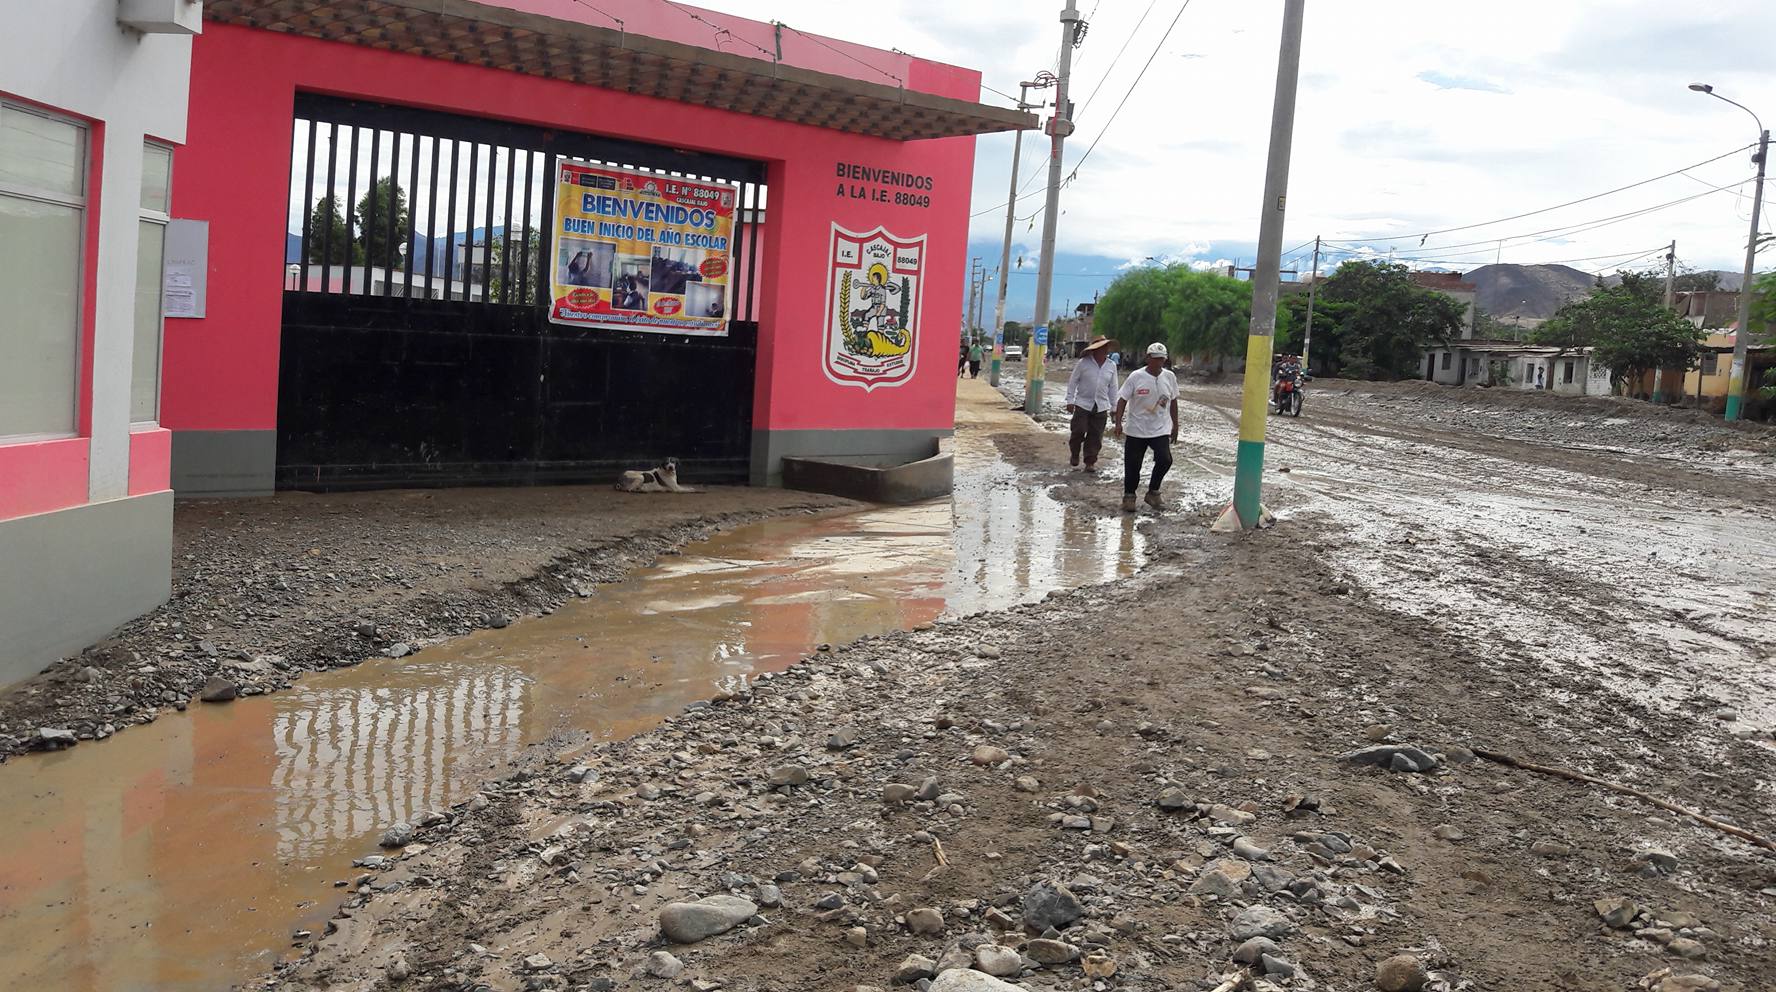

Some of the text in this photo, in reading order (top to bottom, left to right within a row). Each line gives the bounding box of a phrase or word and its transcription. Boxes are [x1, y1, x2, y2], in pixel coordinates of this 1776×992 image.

[837, 163, 933, 191] BIENVENIDOS
[665, 184, 679, 195] I.E.
[693, 188, 720, 200] 88049
[837, 183, 930, 208] A LA I.E. 88049
[582, 193, 716, 229] BIENVENIDOS
[563, 217, 728, 250] BUEN INICIO DEL AÑO ESCOLAR
[841, 250, 853, 258] I.E.
[866, 244, 891, 257] CASCAJAL
[897, 257, 918, 265] 88049
